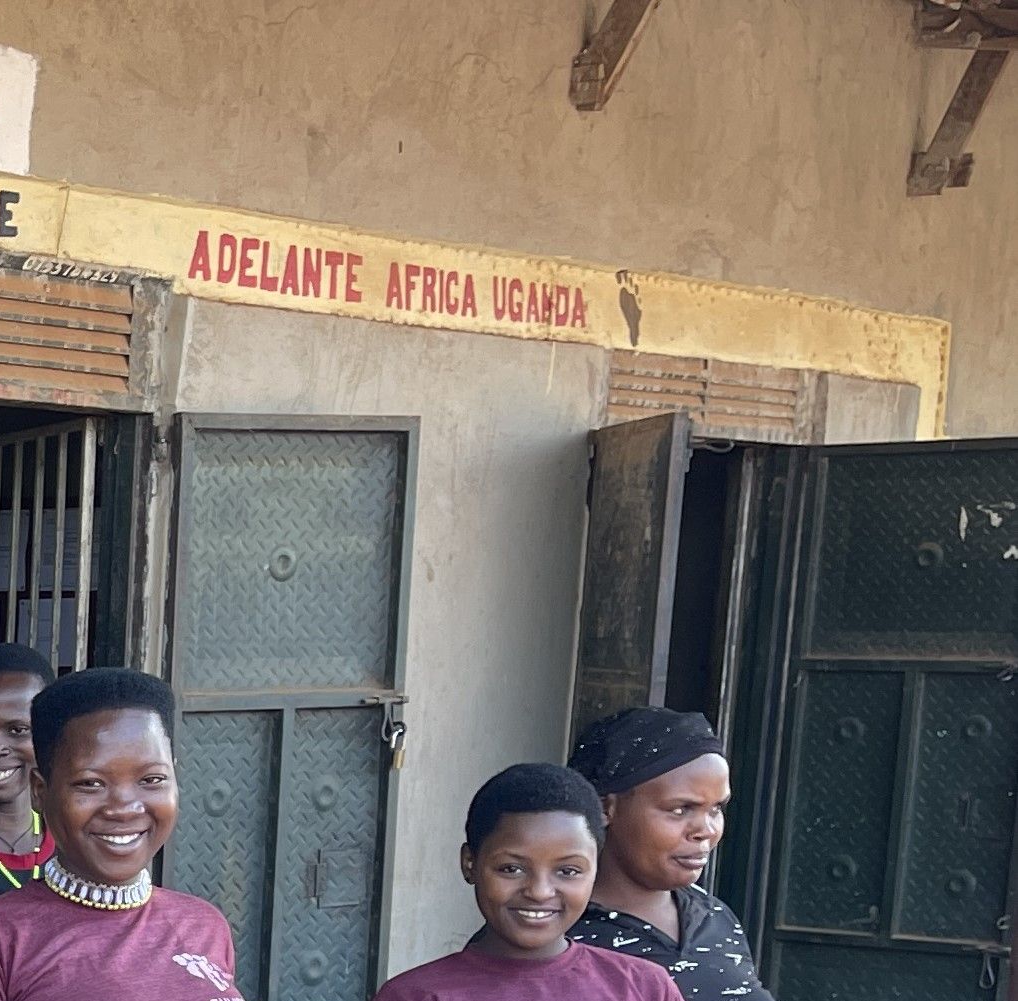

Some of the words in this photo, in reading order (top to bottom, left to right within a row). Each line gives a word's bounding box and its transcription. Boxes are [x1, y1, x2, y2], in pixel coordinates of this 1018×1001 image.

[188, 230, 364, 303] ADELANTE
[385, 261, 478, 318] AFRICA
[492, 275, 587, 329] UGANDA
